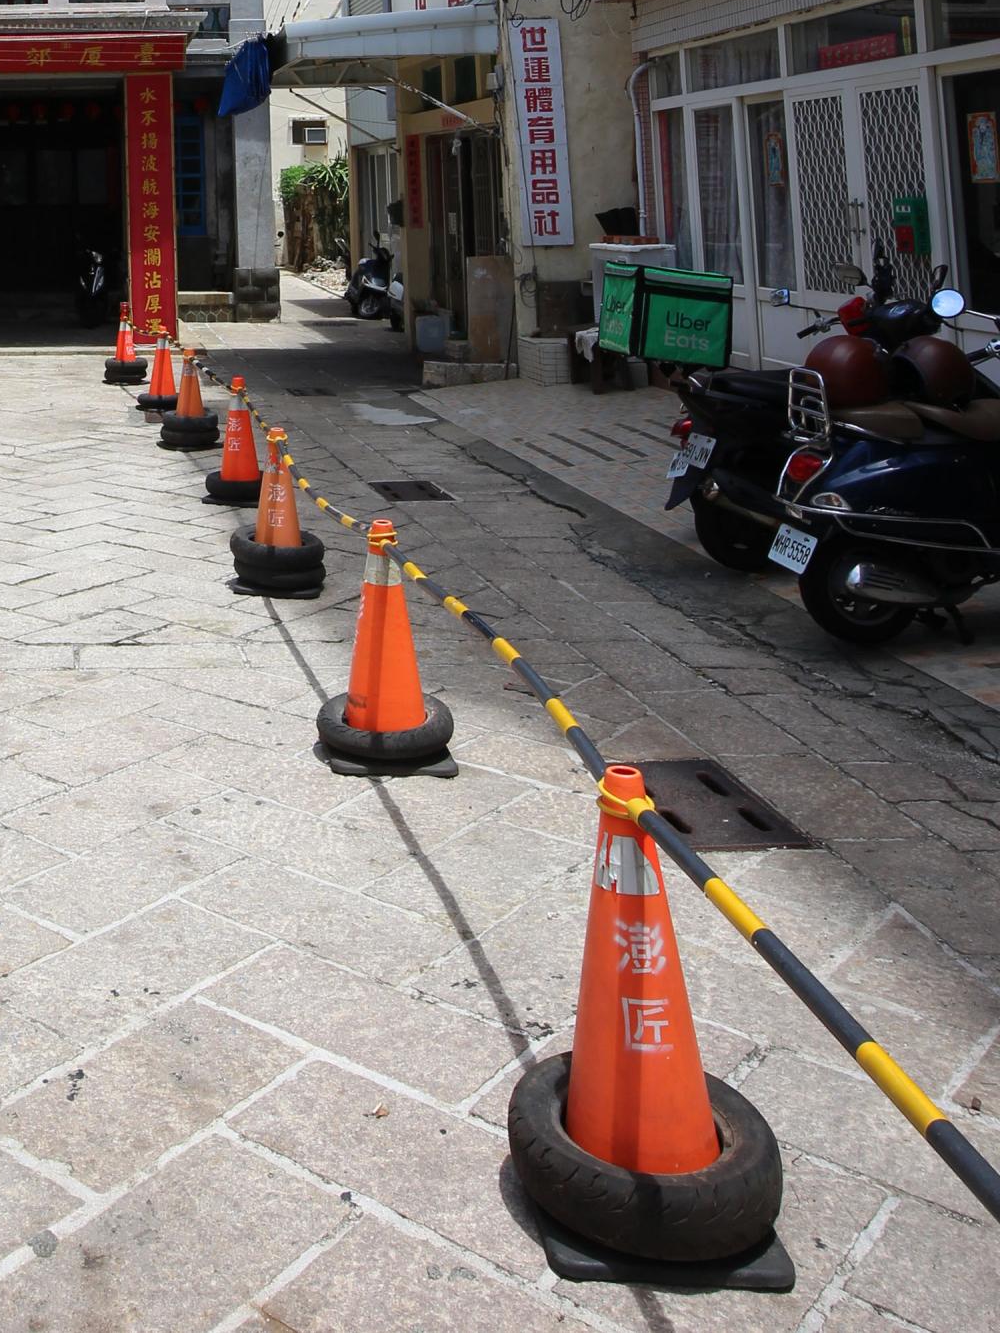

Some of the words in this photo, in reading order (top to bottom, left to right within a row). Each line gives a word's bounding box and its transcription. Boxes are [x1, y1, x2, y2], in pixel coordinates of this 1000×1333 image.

[520, 26, 560, 236] 世運體育用品社
[663, 329, 709, 351] Eats
[666, 310, 711, 332] Uber
[614, 918, 675, 1052] 澎匠
